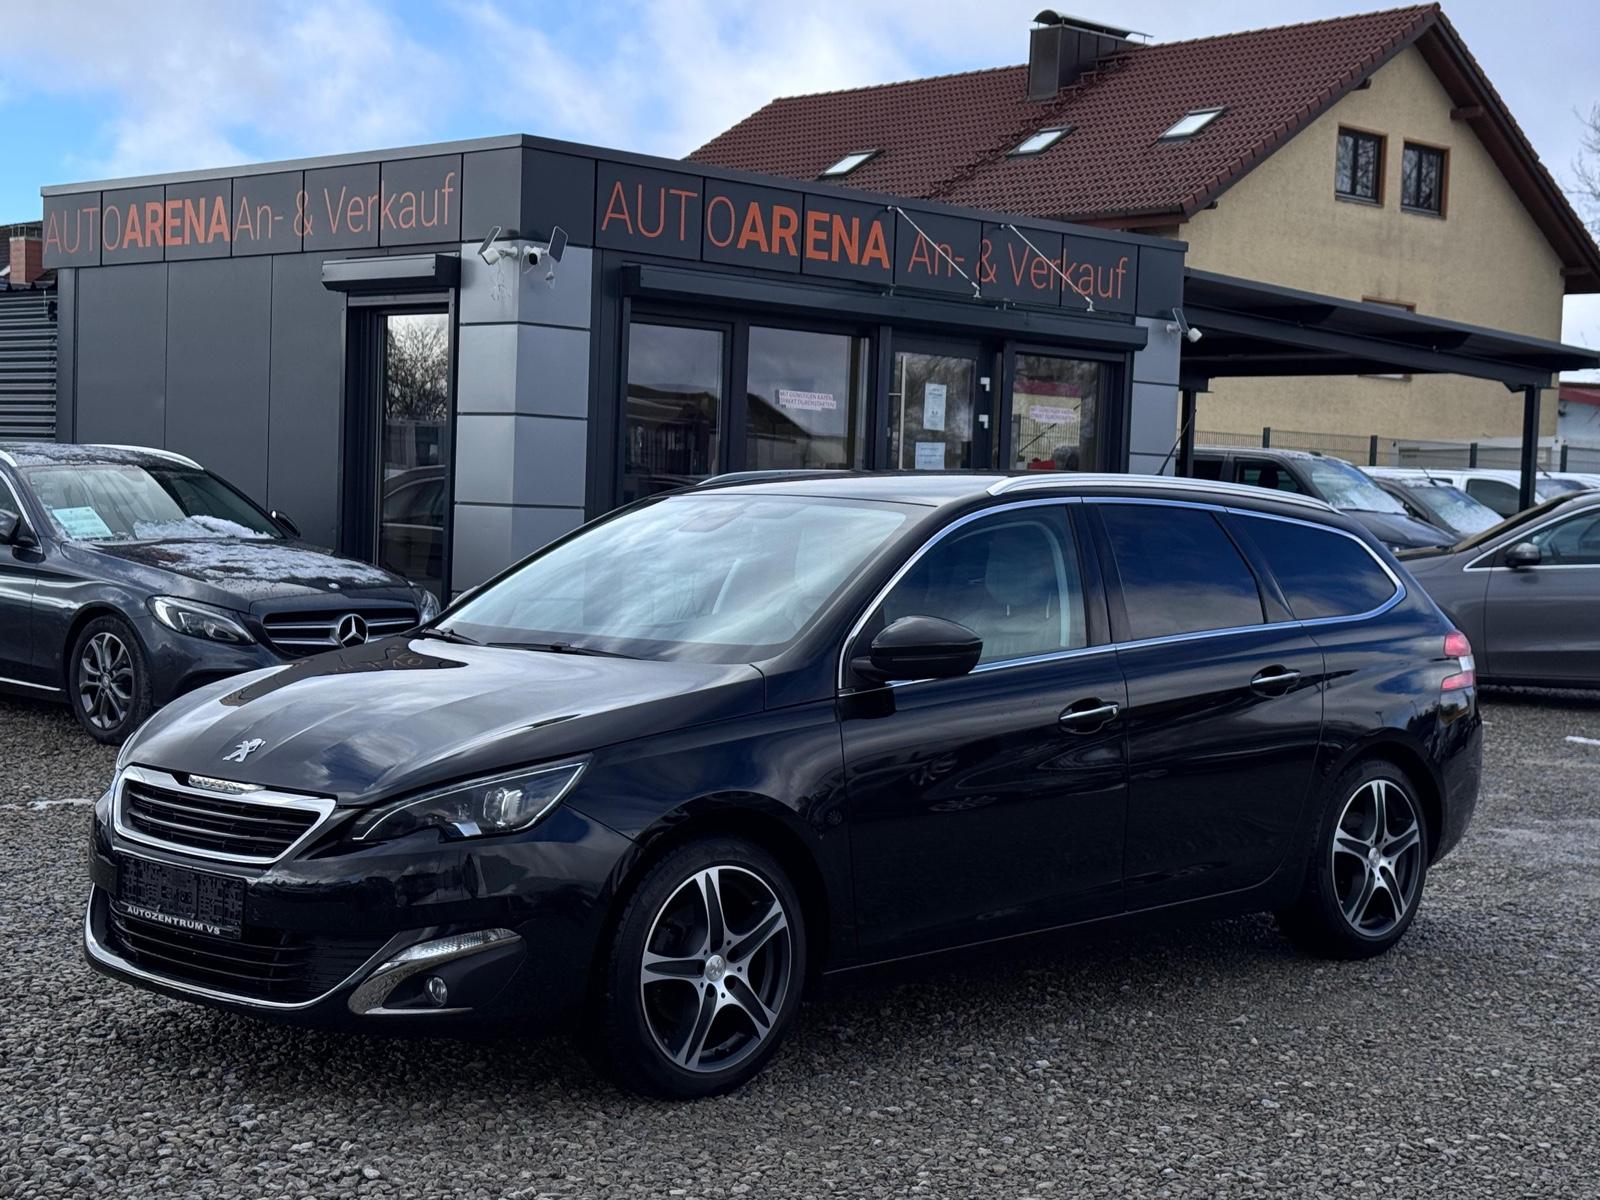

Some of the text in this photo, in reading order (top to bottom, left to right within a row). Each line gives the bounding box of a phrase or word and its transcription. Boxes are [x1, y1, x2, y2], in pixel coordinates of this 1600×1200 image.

[43, 171, 456, 255] AUTOARENA An- & Verkauf
[601, 180, 1128, 300] AUTOARENA An- & Verkauf
[127, 905, 221, 936] AUTOZENTRUM VS
